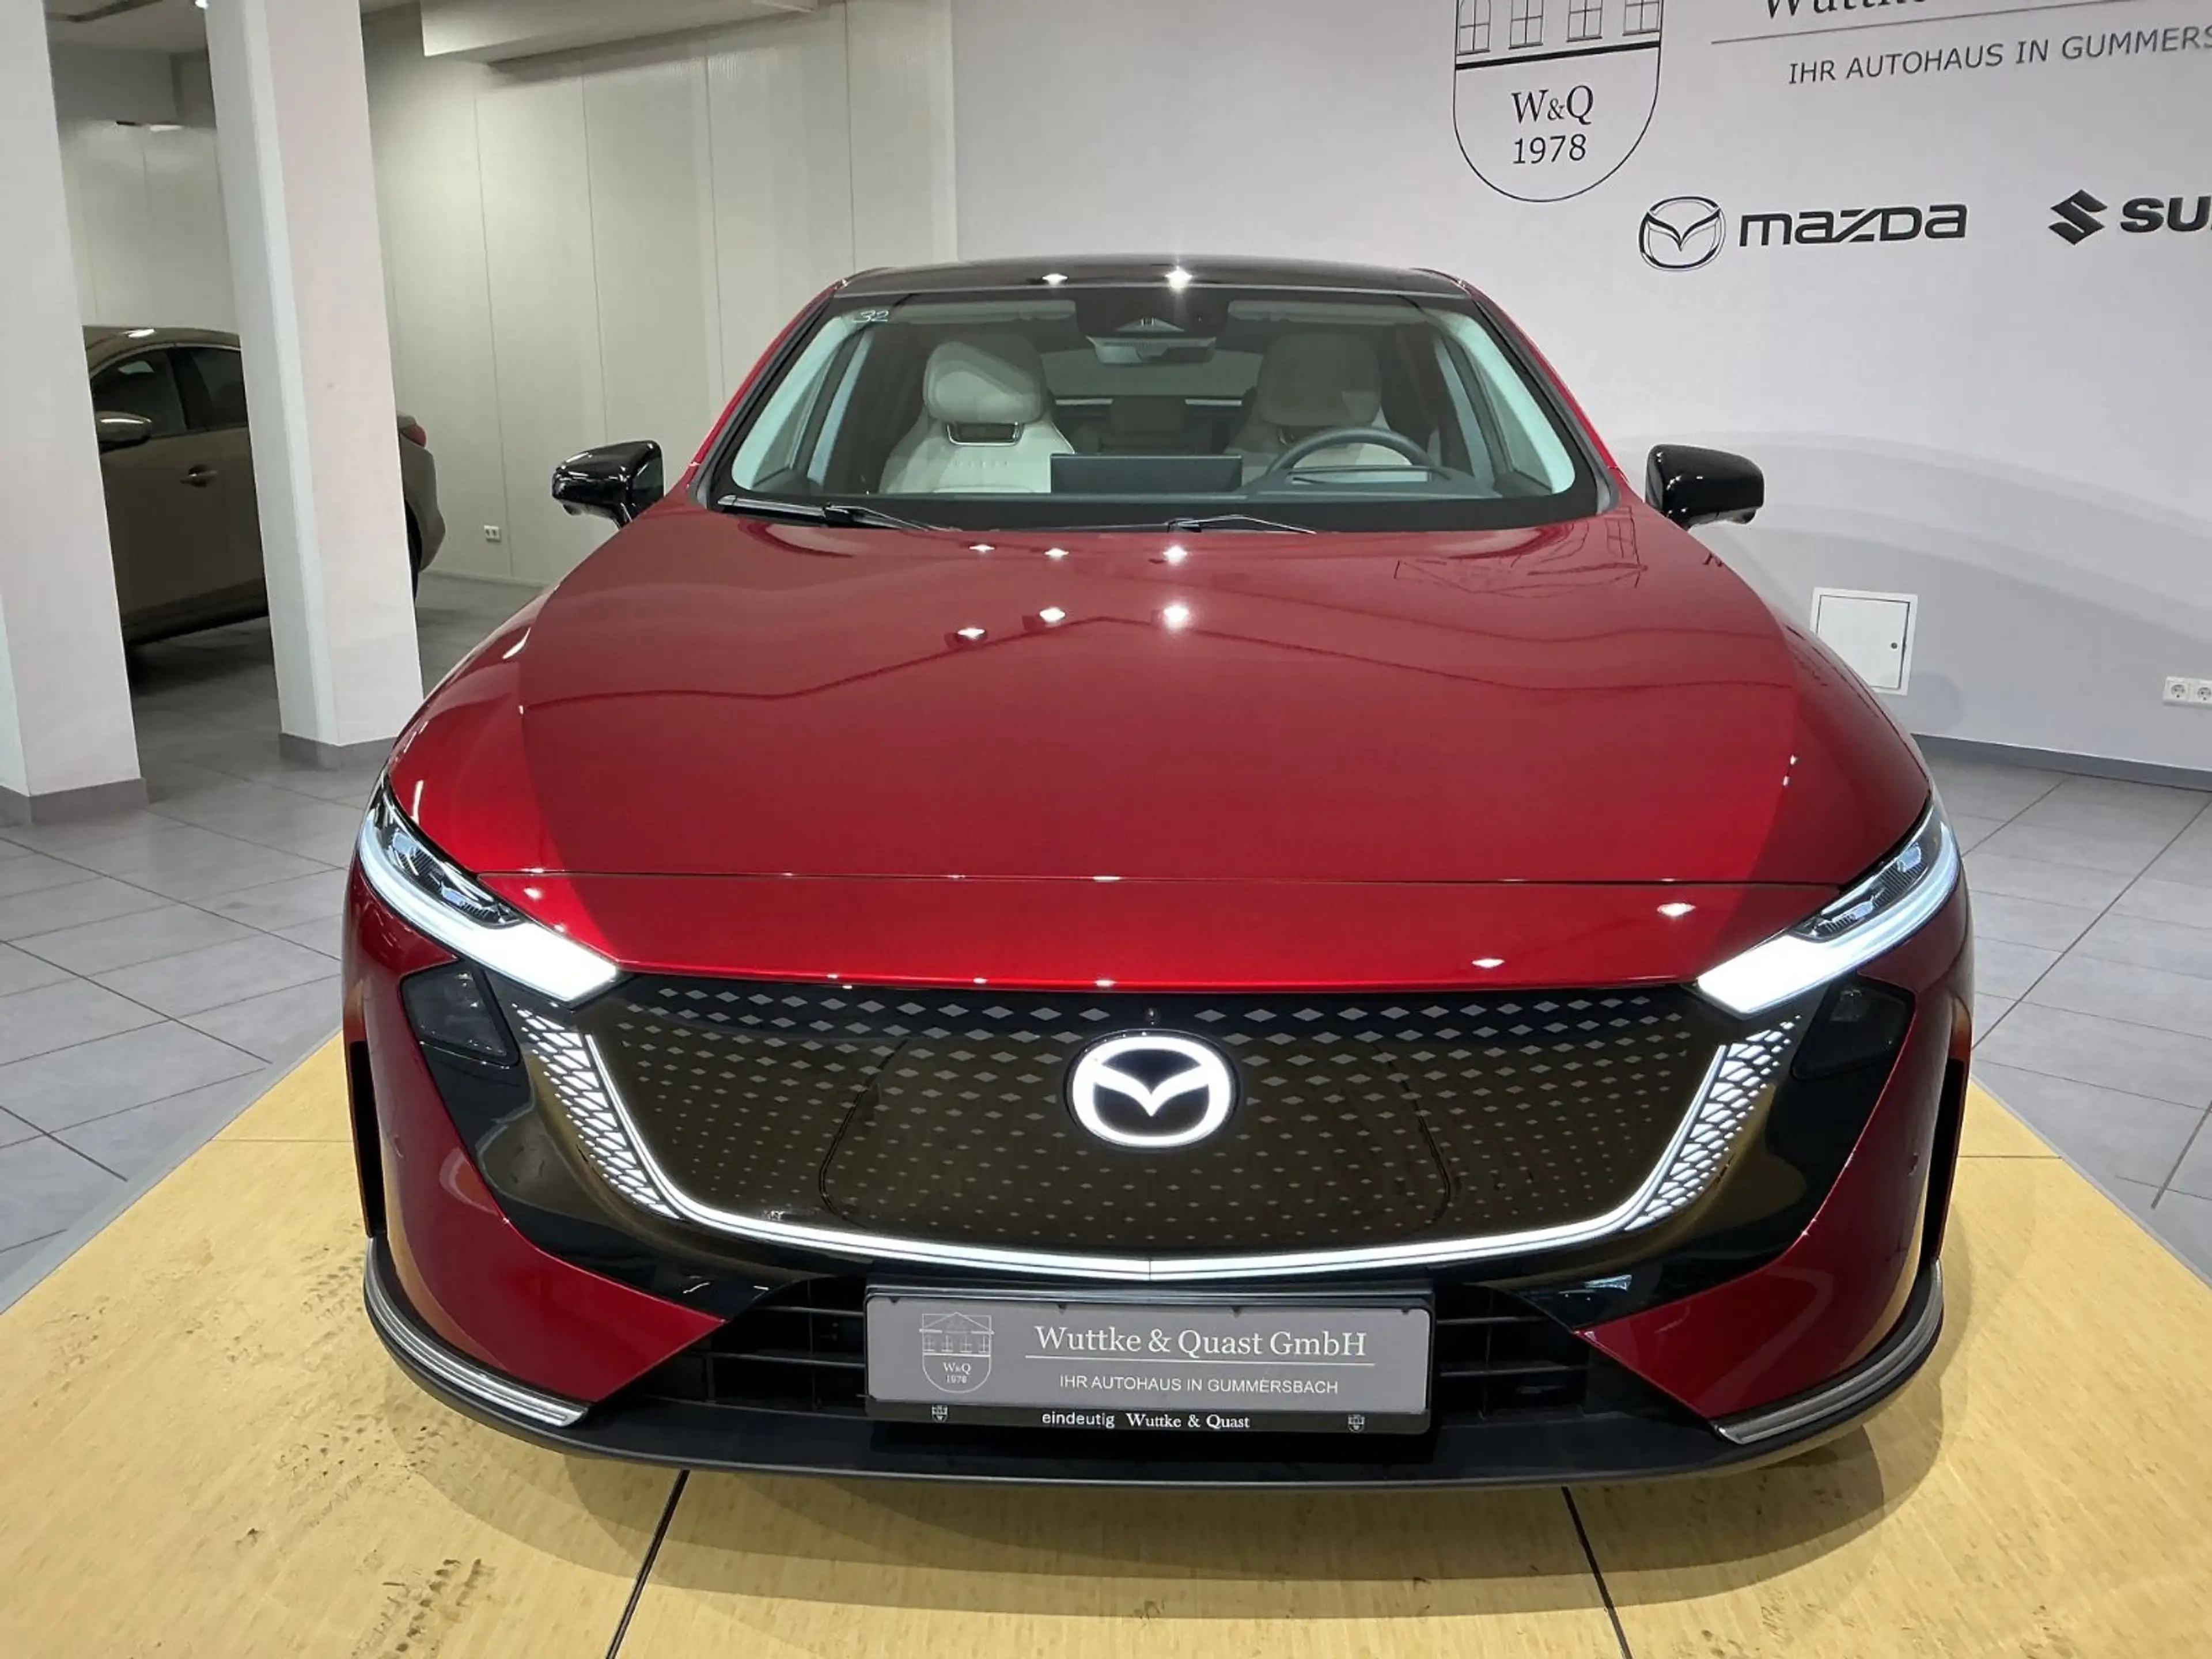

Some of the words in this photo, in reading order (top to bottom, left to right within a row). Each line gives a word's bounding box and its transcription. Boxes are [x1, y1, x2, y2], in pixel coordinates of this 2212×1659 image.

[1789, 60, 1836, 84] IHR
[1846, 43, 2004, 79] AUTOHAUS
[2016, 39, 2048, 65] IN
[1511, 85, 1594, 125] W&Q
[1513, 134, 1587, 164] 1978
[2120, 195, 2212, 233] SU
[1034, 1325, 1142, 1353] Wuttke
[1148, 1328, 1172, 1353] &
[1177, 1330, 1263, 1358] Quast
[1270, 1331, 1367, 1357] GmbH
[1060, 1374, 1088, 1389] IHR
[1091, 1376, 1181, 1392] AUTOHAUS
[1187, 1378, 1202, 1391] IN
[1207, 1378, 1338, 1395] GUMMERSBACH
[1042, 1411, 1115, 1429] eindeutig
[1126, 1412, 1181, 1428] Wuttke
[1187, 1414, 1200, 1428] &
[1206, 1414, 1251, 1430] Quast
